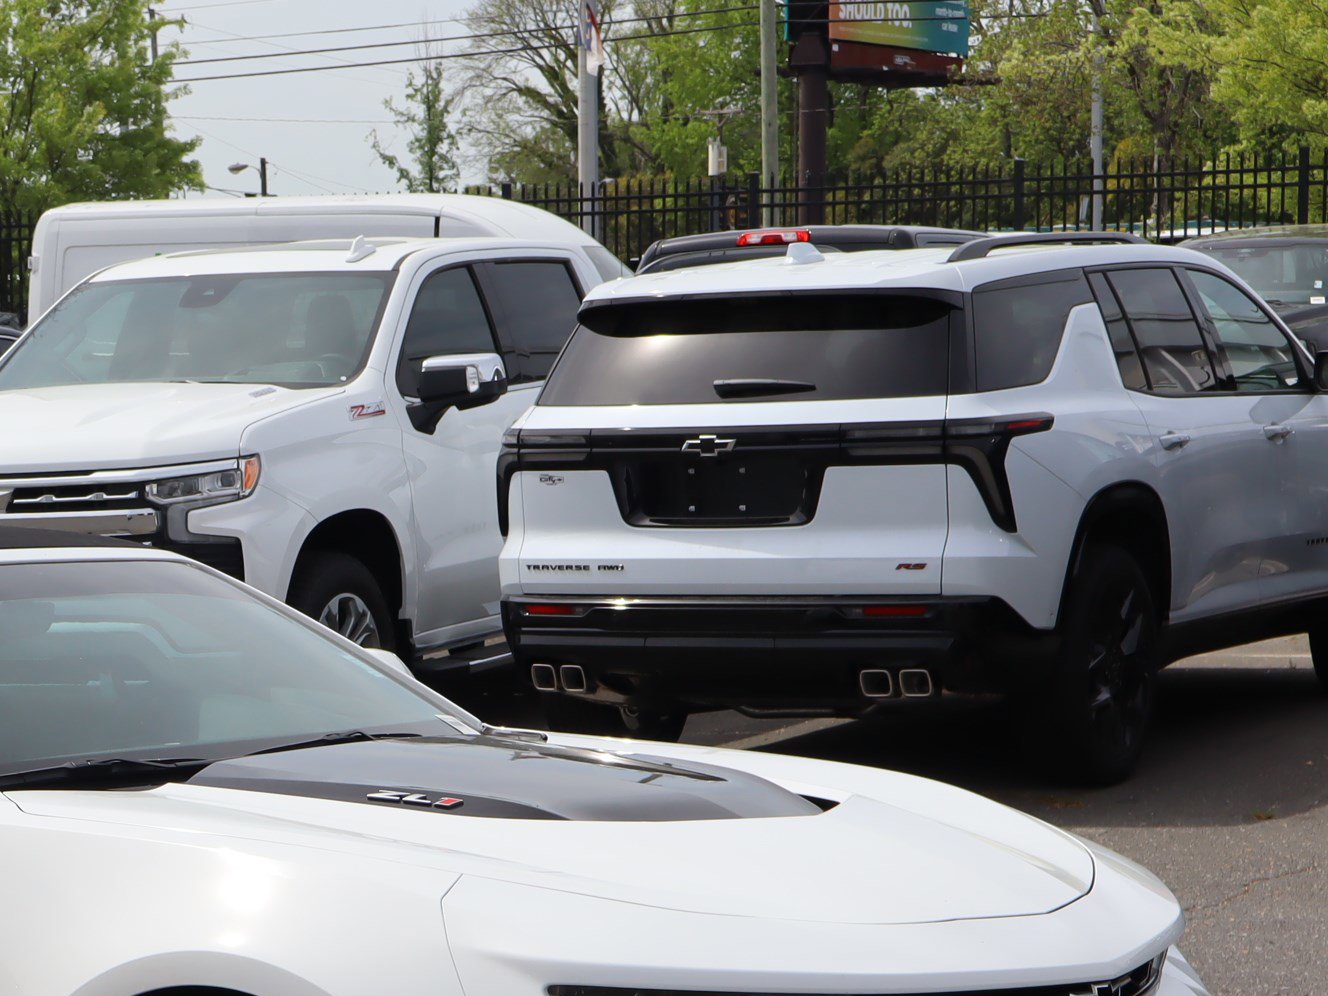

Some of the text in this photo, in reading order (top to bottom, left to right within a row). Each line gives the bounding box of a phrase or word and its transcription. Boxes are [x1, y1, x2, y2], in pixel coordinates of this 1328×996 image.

[839, 3, 885, 24] SHOULD
[895, 562, 928, 571] RS
[366, 790, 464, 810] ZL1
